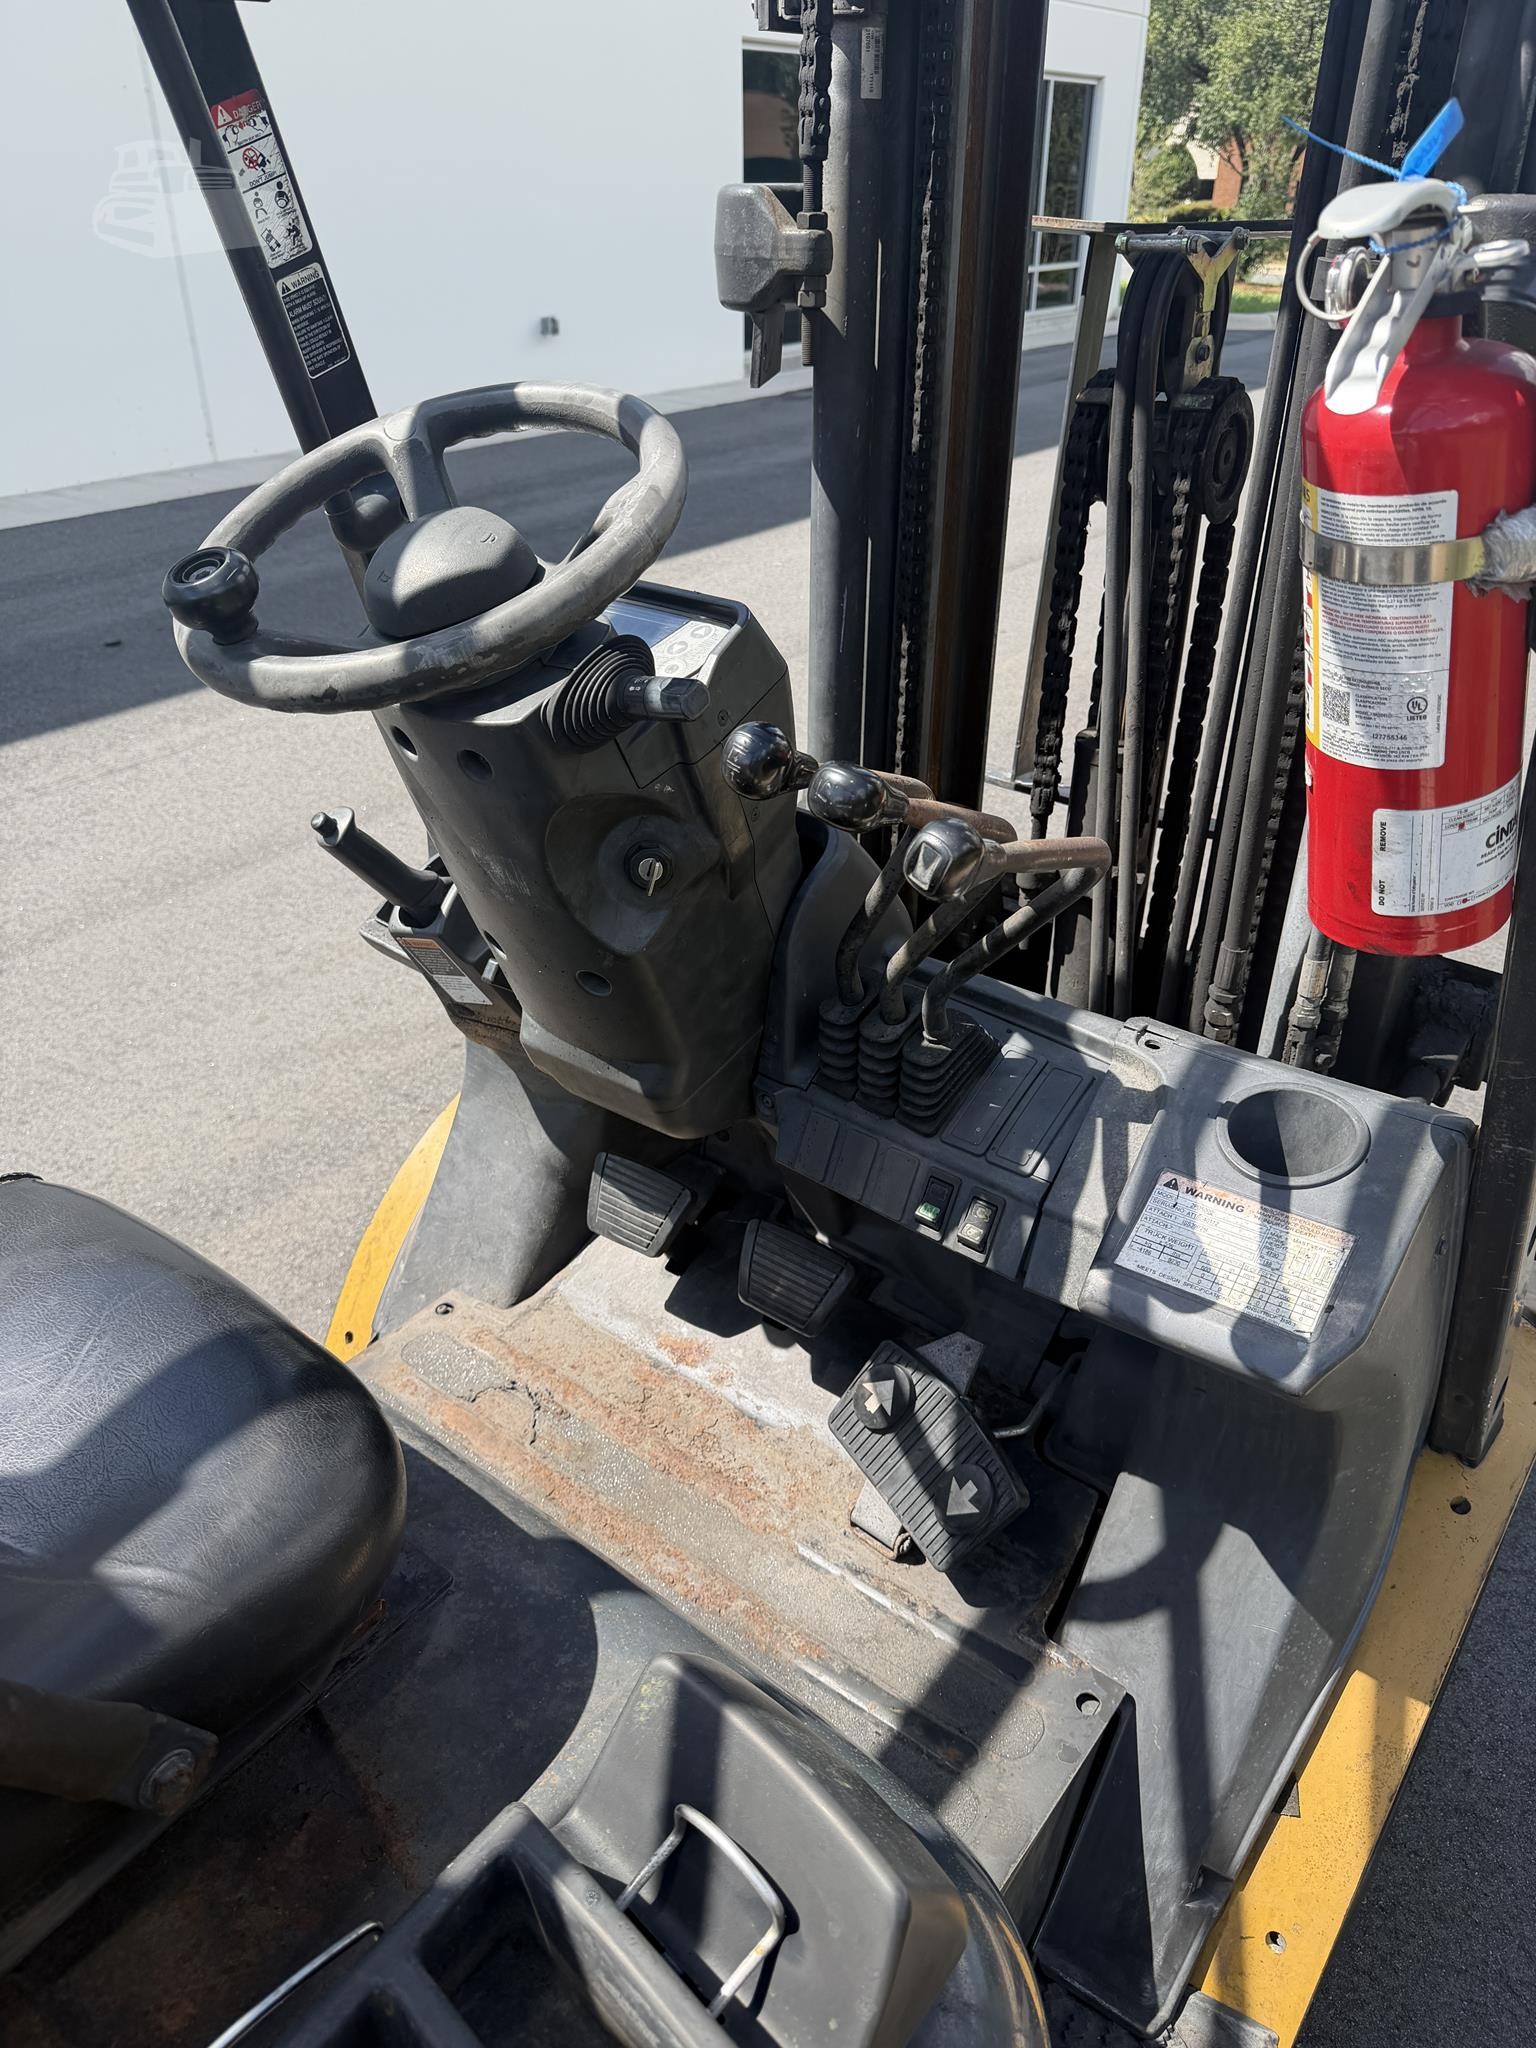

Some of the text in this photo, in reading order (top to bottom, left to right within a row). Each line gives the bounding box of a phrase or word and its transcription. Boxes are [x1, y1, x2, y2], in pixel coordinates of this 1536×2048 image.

[232, 101, 262, 119] DGER
[291, 270, 320, 289] WARNING
[1378, 821, 1387, 906] DO NOT REMOVE
[1183, 1185, 1246, 1214] WARNING
[1143, 1227, 1195, 1251] TRUCK WEIGHT
[1135, 1263, 1157, 1275] MEETS
[1157, 1271, 1181, 1284] DESIGN
